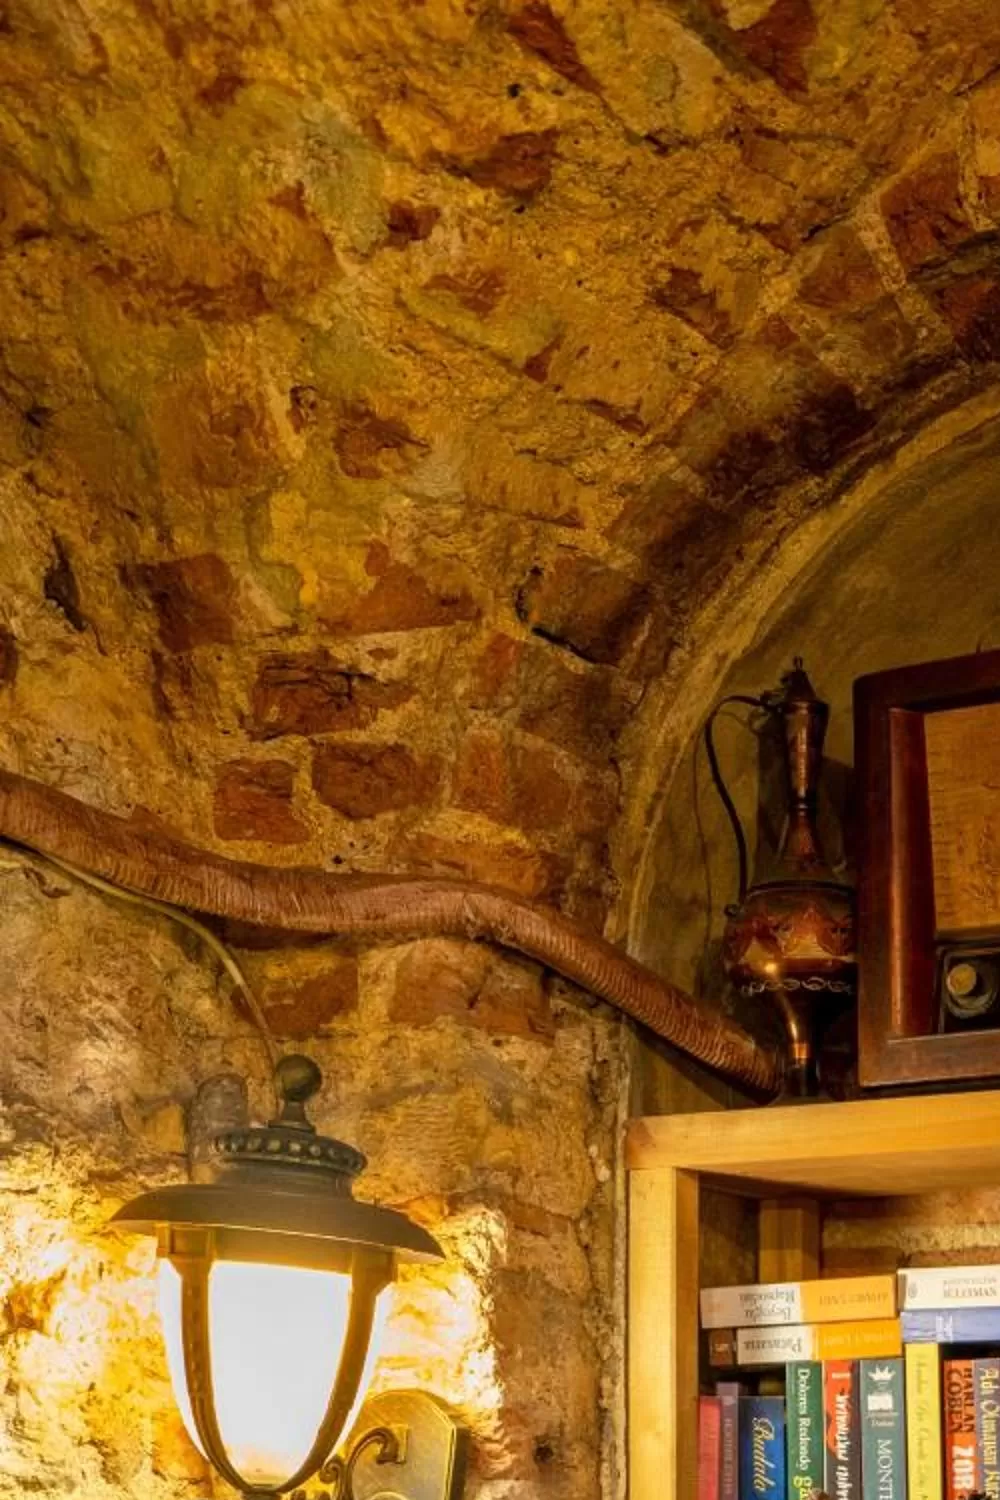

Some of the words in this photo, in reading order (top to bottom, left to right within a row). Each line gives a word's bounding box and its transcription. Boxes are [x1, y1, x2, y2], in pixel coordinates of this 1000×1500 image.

[797, 1367, 812, 1414] Dolores
[947, 1367, 962, 1436] COBEN
[963, 1367, 975, 1434] HARLAN
[796, 1417, 812, 1471] Redondo
